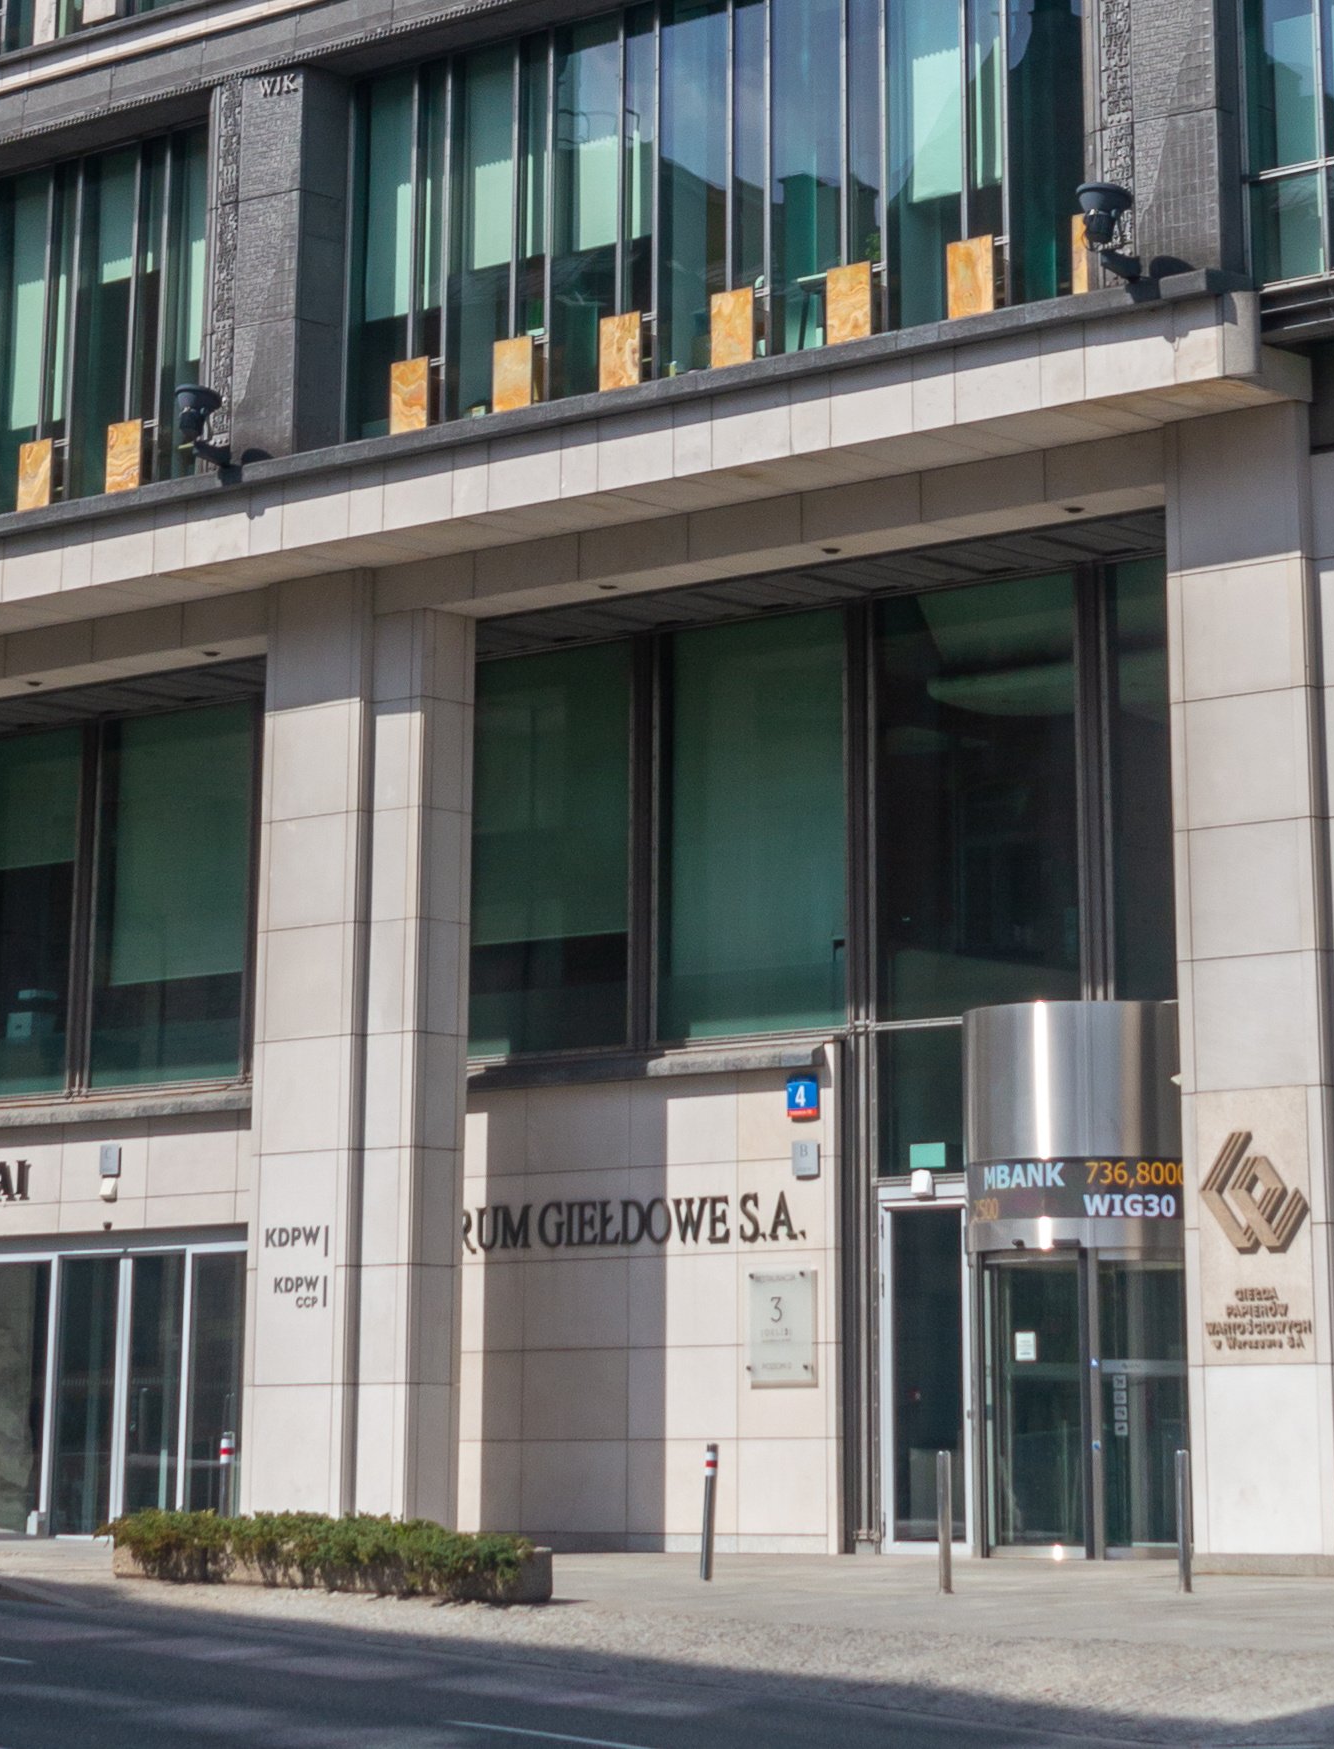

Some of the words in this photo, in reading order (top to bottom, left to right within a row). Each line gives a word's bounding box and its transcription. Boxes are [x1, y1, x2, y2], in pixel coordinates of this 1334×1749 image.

[794, 1084, 807, 1108] 4
[984, 1161, 1066, 1191] MBANK
[1083, 1192, 1176, 1218] WIG30
[537, 1196, 731, 1250] GIEŁDOWE
[738, 1190, 806, 1245] S.A.
[265, 1225, 321, 1249] KDPW
[273, 1275, 319, 1294] KDPW
[296, 1296, 318, 1308] CCP
[770, 1296, 783, 1323] 3
